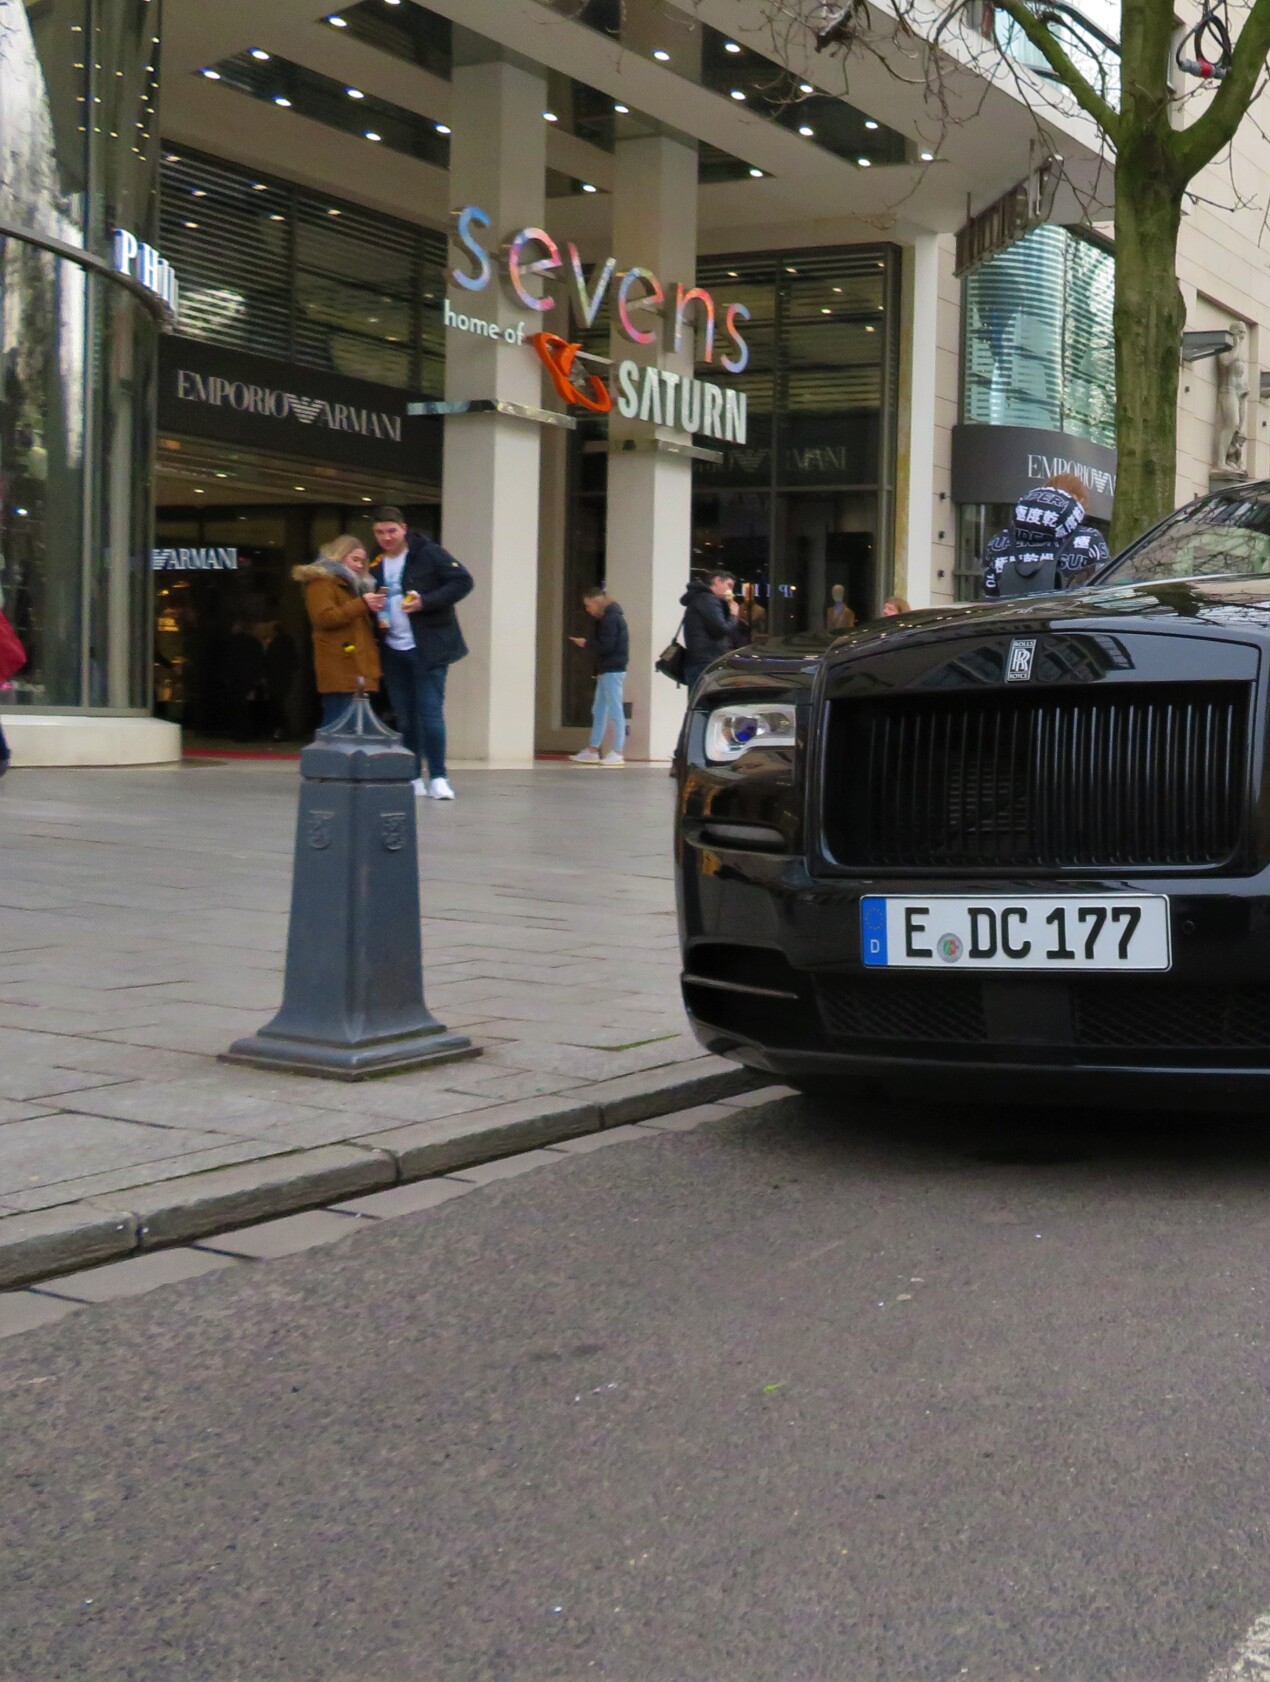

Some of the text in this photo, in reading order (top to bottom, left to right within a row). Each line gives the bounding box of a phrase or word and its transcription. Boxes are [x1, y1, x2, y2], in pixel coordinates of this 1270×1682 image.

[444, 299, 525, 346] home of
[177, 369, 402, 442] EMPORIO ARMANI
[617, 360, 748, 445] SATURN
[166, 547, 238, 570] ARMANI
[870, 906, 1142, 960] D E DC 177
